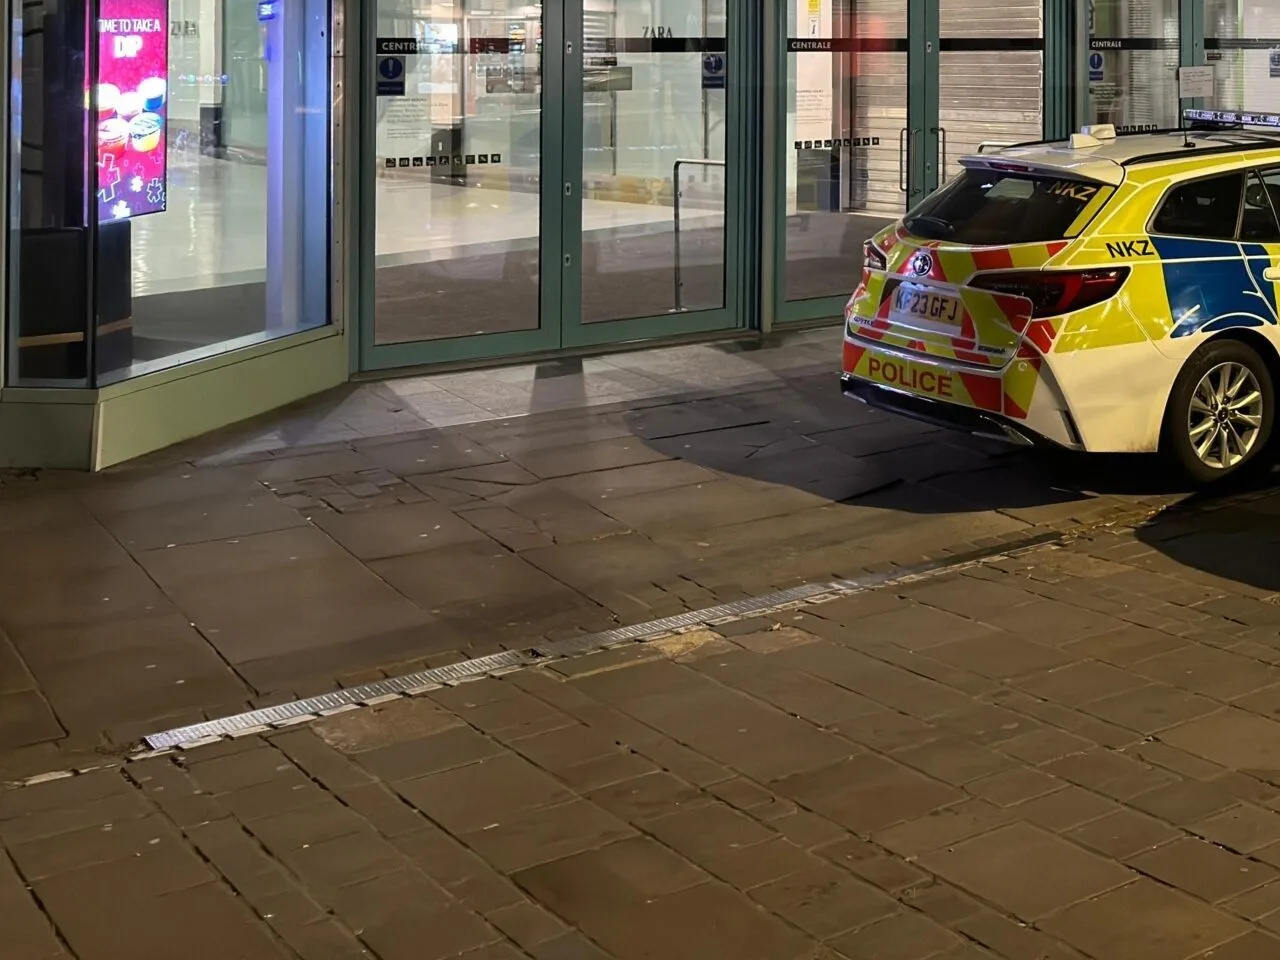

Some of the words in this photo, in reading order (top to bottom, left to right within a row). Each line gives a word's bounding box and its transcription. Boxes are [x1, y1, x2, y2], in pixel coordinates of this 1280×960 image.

[791, 41, 832, 49] CENTRALE
[1091, 40, 1122, 49] CENTRALE
[1105, 240, 1155, 258] NKZ
[929, 295, 959, 321] GFJ
[868, 356, 954, 398] POLICE
